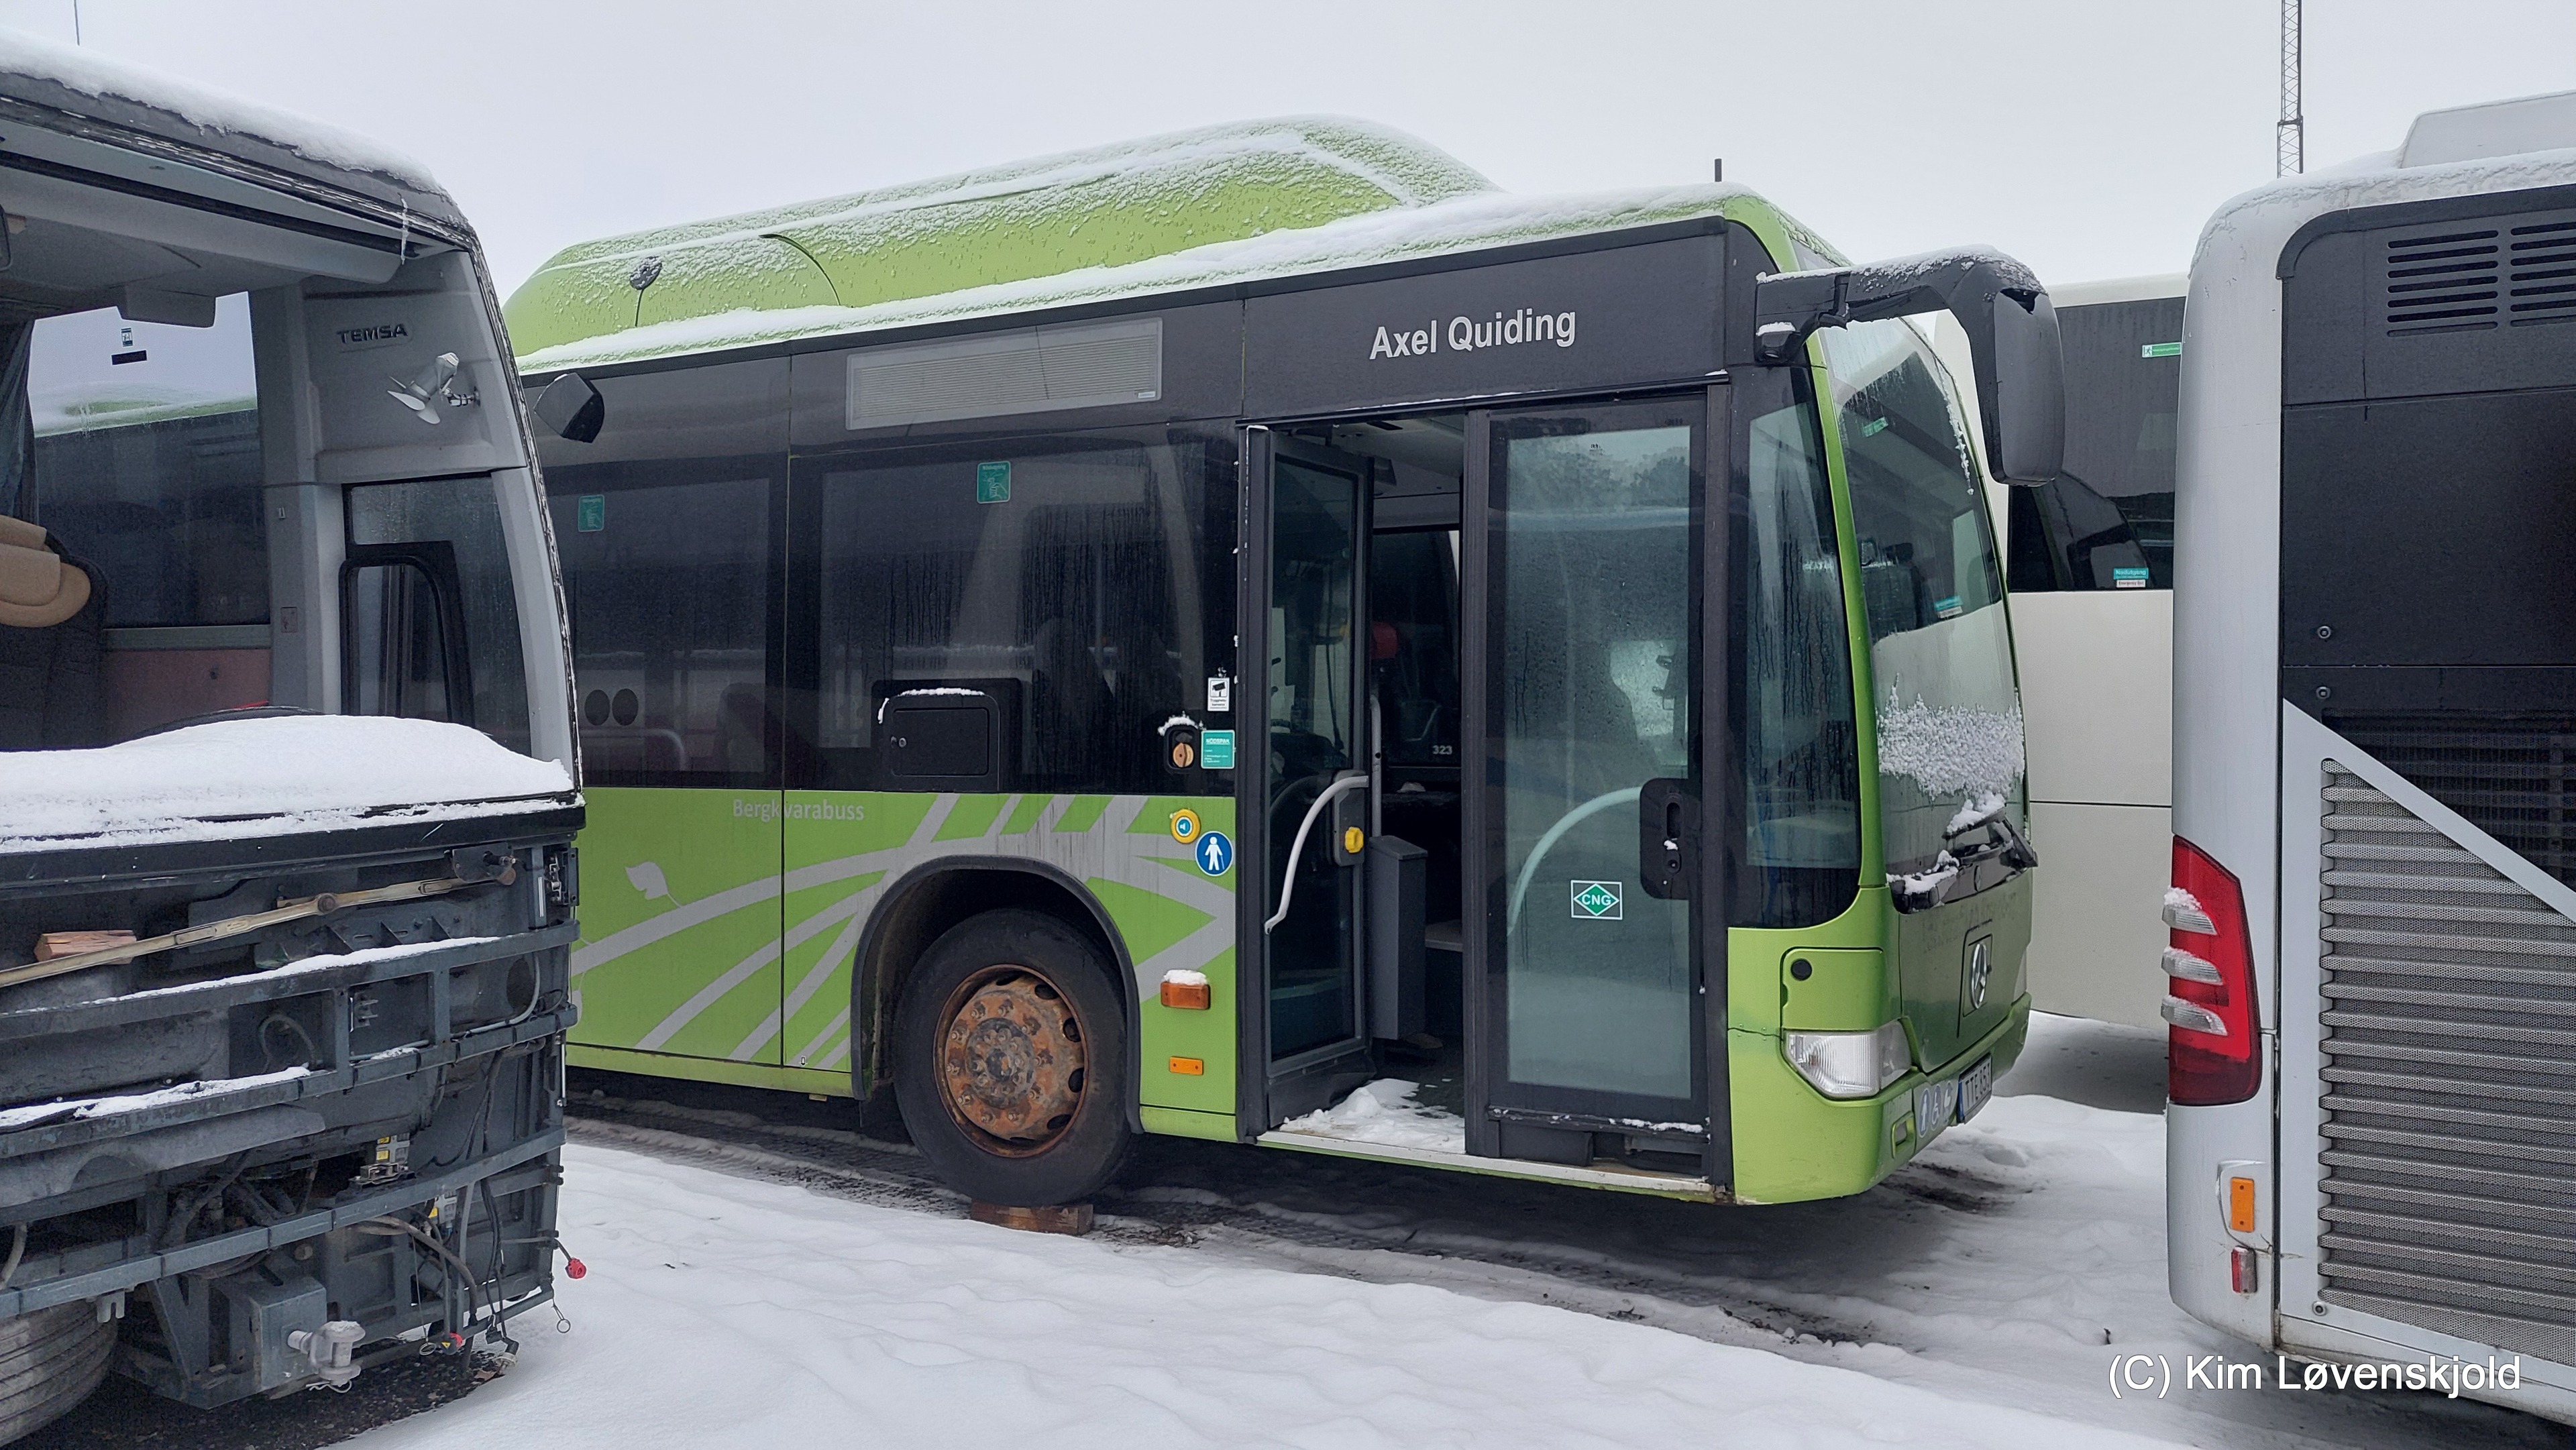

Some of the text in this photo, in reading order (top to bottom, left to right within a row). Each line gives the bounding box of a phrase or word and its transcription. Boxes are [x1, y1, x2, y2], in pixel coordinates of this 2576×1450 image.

[337, 323, 408, 343] TEMSA
[1369, 308, 1576, 360] Axel Quiding
[1432, 745, 1452, 755] 323
[733, 799, 865, 822] Bergkvarabuss
[1581, 894, 1611, 905] CNG
[1966, 1073, 1978, 1108] TTE
